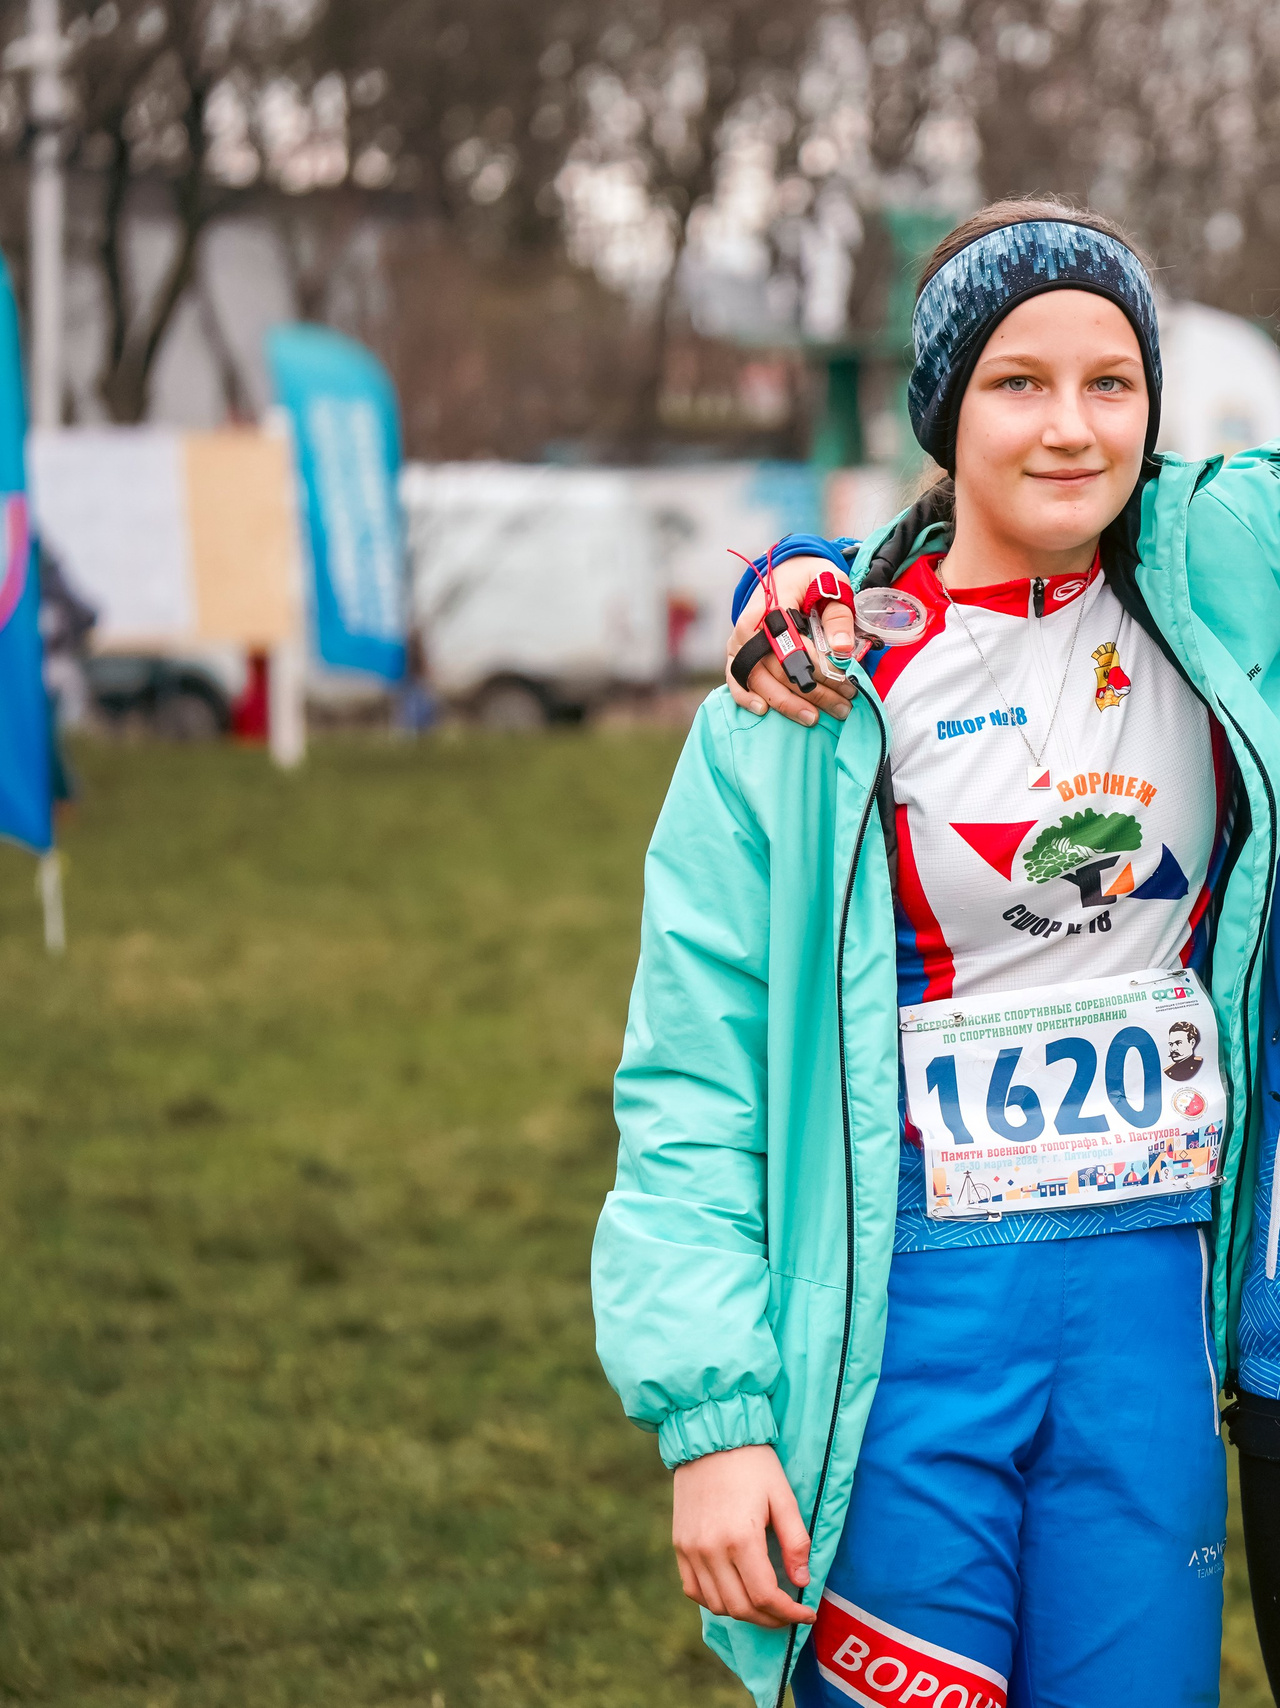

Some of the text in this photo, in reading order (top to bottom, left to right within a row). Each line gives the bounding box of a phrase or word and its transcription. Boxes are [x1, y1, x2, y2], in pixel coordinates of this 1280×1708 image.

[937, 707, 1028, 740] СШОР №18
[1056, 772, 1157, 808] ВОРОНЕЖ
[1002, 904, 1062, 938] СШОР
[917, 991, 1147, 1032] ВСЕРОСИЙСКИЕ СПОРТИВНЫЕ СОРЕВНОВАНИЯ
[943, 1009, 1127, 1044] ПО СПОРТИВНОМУ ОРИЕНТИРОВАНИЮ
[926, 1026, 1162, 1145] 1620
[941, 1127, 1180, 1162] Памяти военного топографа А. В. Пастухова
[983, 1159, 1012, 1170] марта
[1015, 1155, 1038, 1166] 2026
[1064, 1148, 1113, 1161] Пятигорск
